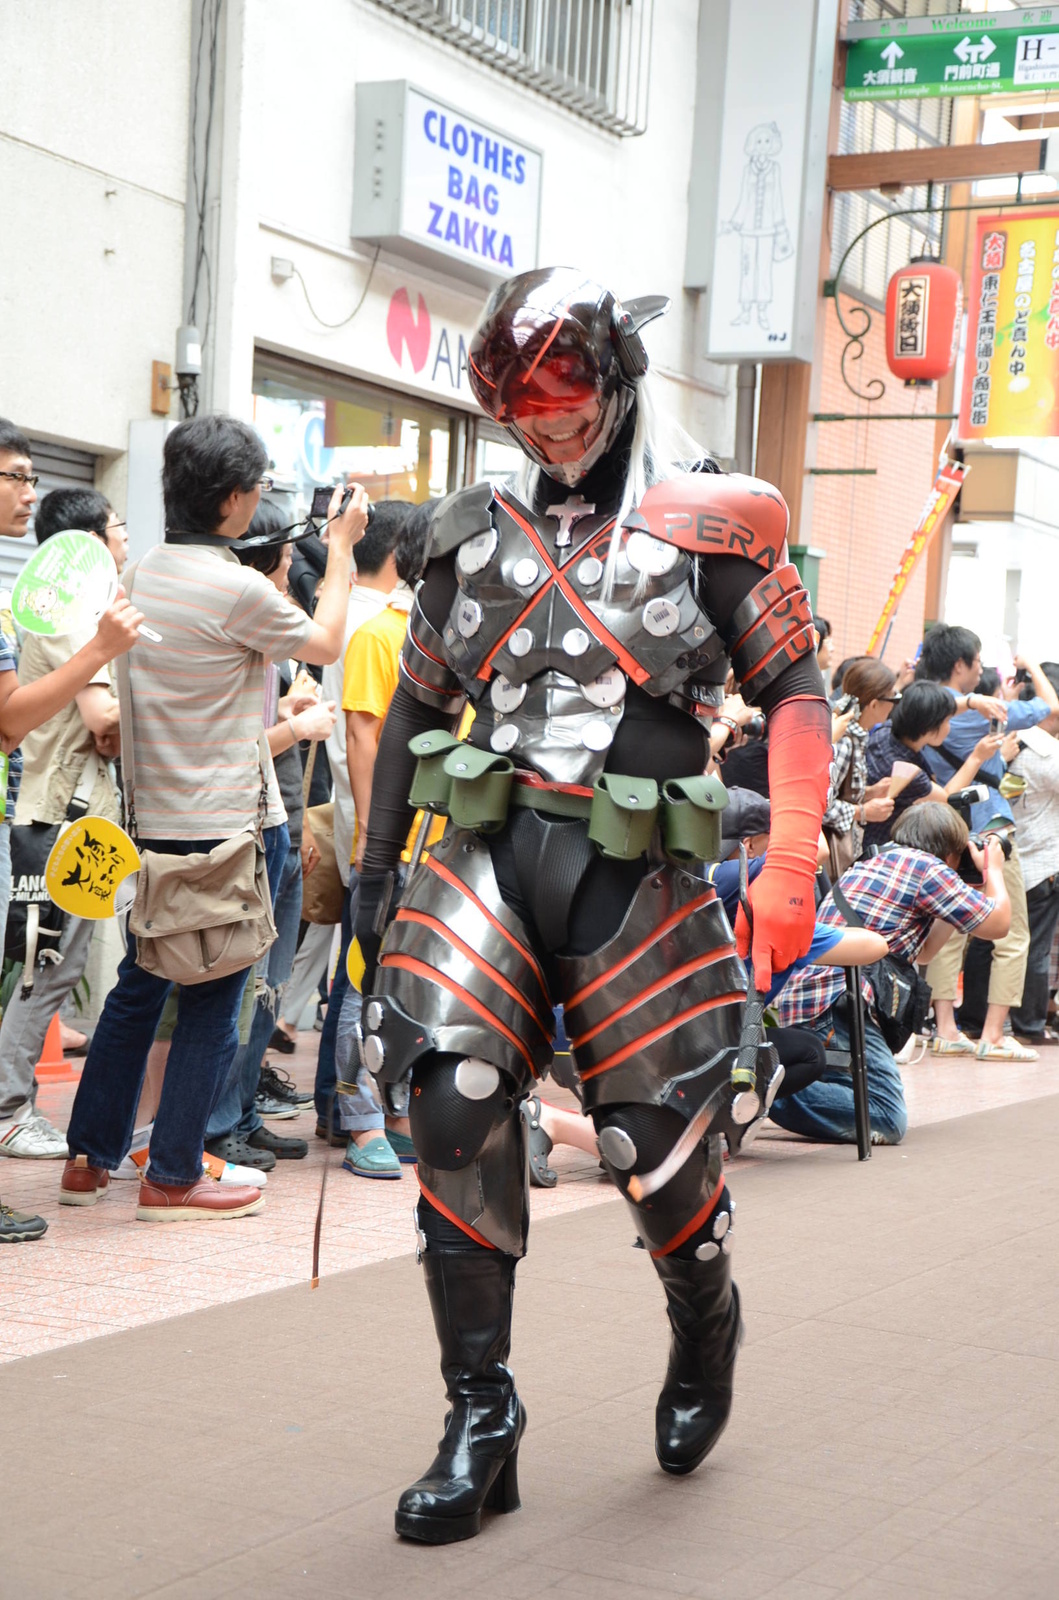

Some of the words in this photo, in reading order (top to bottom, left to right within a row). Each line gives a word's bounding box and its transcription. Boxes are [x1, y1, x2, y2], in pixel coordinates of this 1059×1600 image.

[931, 17, 997, 32] Welcome
[423, 110, 527, 185] CLOTHES
[447, 165, 499, 216] BAG
[427, 201, 514, 268] ZAKKA
[663, 512, 776, 571] PERA
